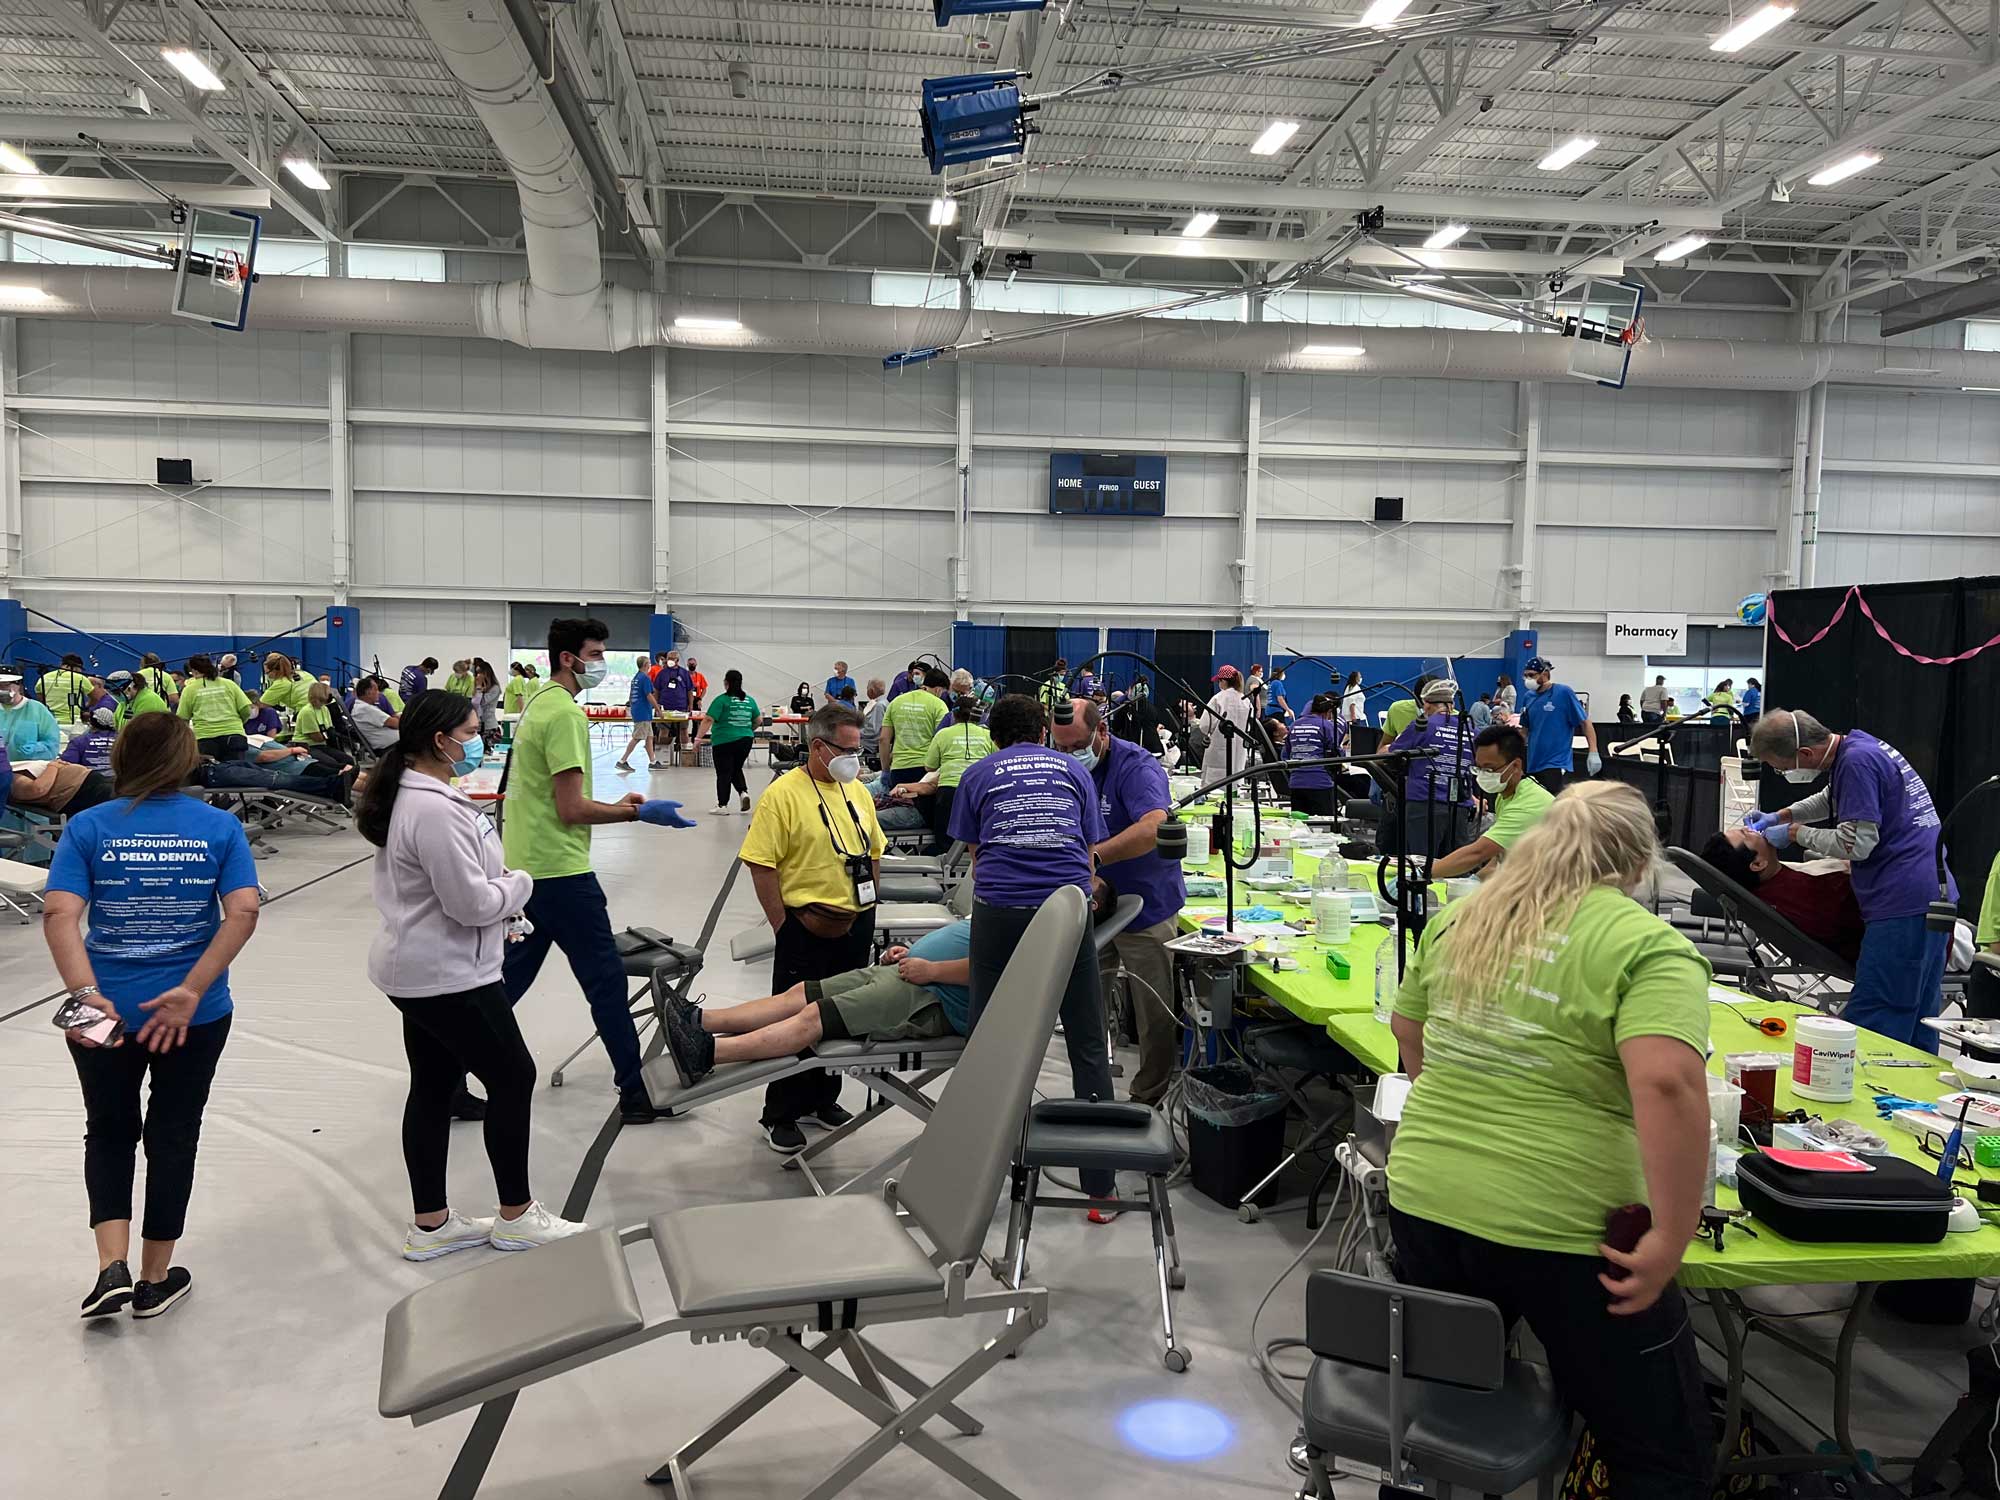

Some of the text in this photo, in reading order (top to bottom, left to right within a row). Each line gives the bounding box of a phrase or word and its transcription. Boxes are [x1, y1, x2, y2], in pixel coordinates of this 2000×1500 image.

[1058, 479, 1082, 488] HOME
[1133, 480, 1161, 490] GUEST
[1615, 624, 1678, 640] Pharmacy
[1006, 763, 1033, 772] DELTA
[119, 852, 206, 861] DELTA DENTAL
